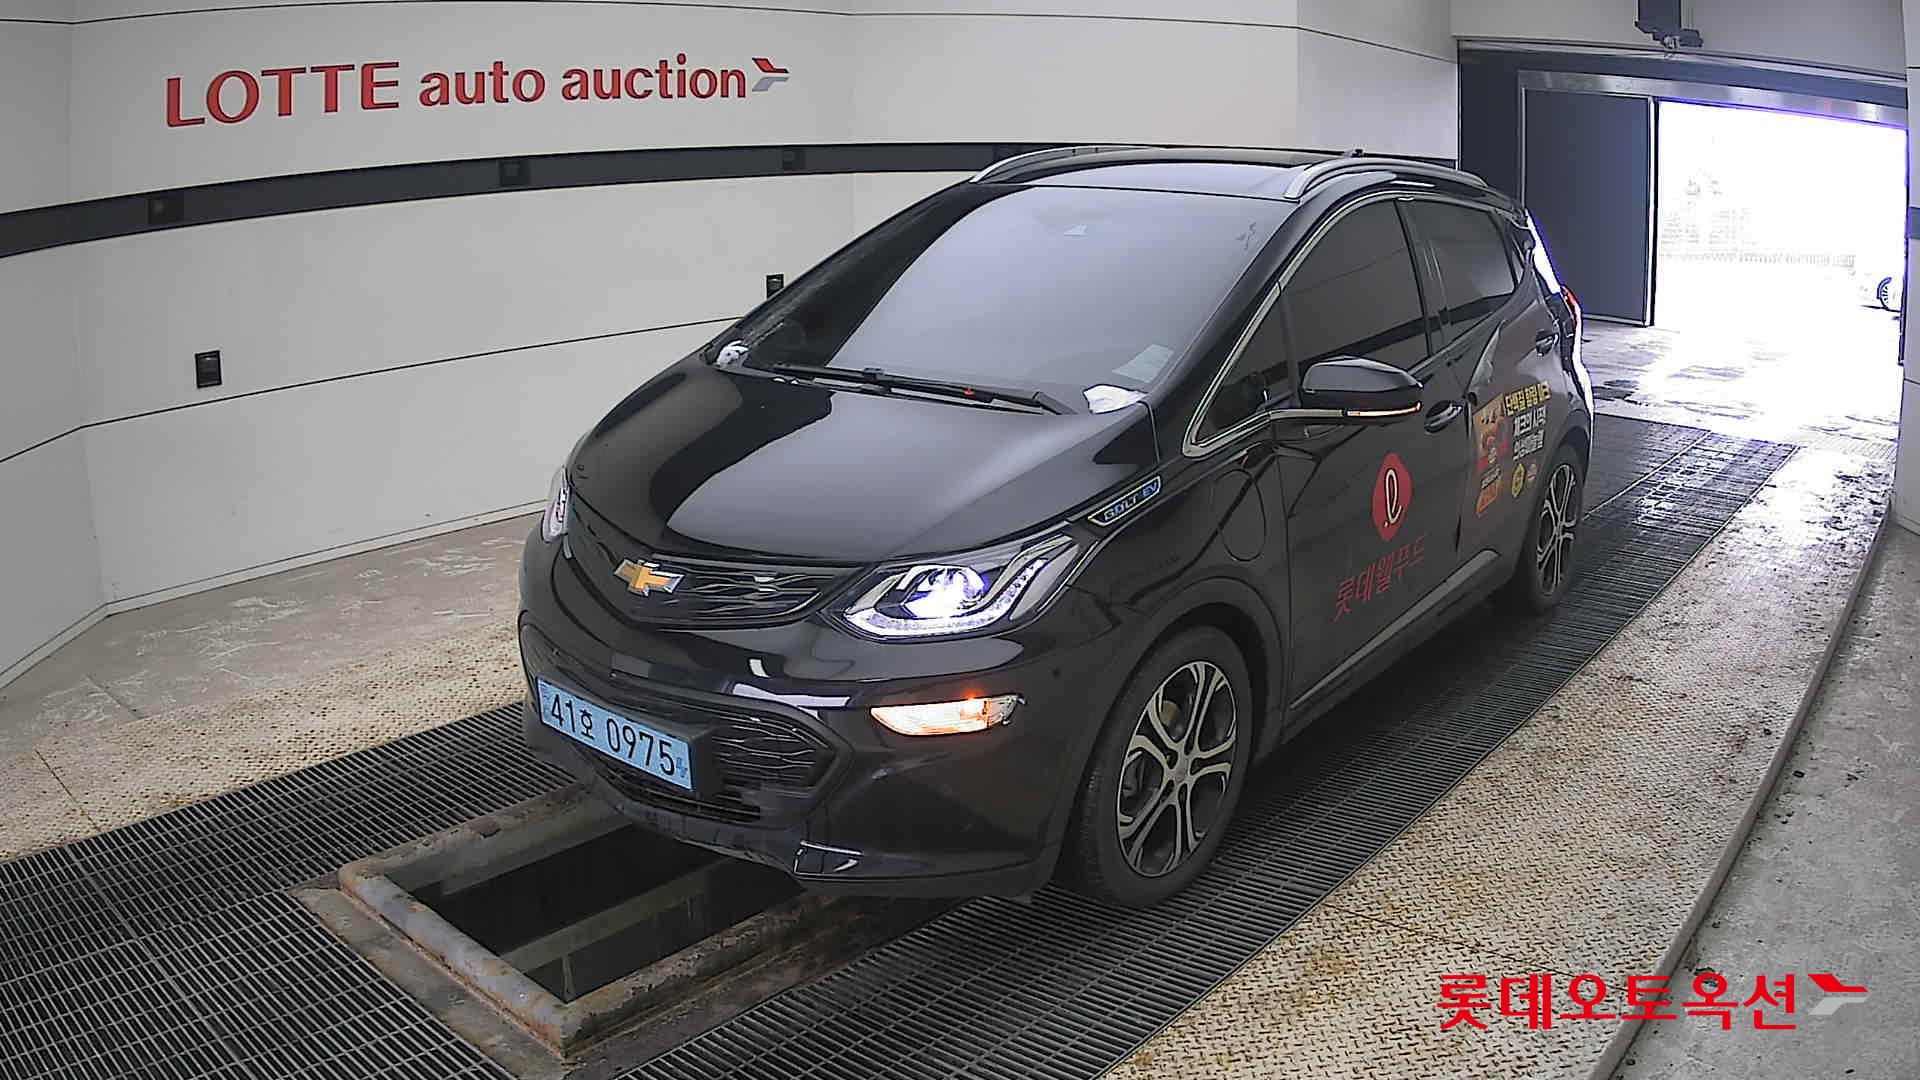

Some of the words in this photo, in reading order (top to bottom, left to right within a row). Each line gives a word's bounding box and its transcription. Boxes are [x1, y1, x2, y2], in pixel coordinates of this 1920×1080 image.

[165, 61, 400, 127] LOTTE
[419, 60, 547, 107] auto
[561, 53, 748, 101] auction
[1142, 481, 1158, 498] EV
[551, 694, 595, 741] 41호
[606, 717, 676, 776] 0975
